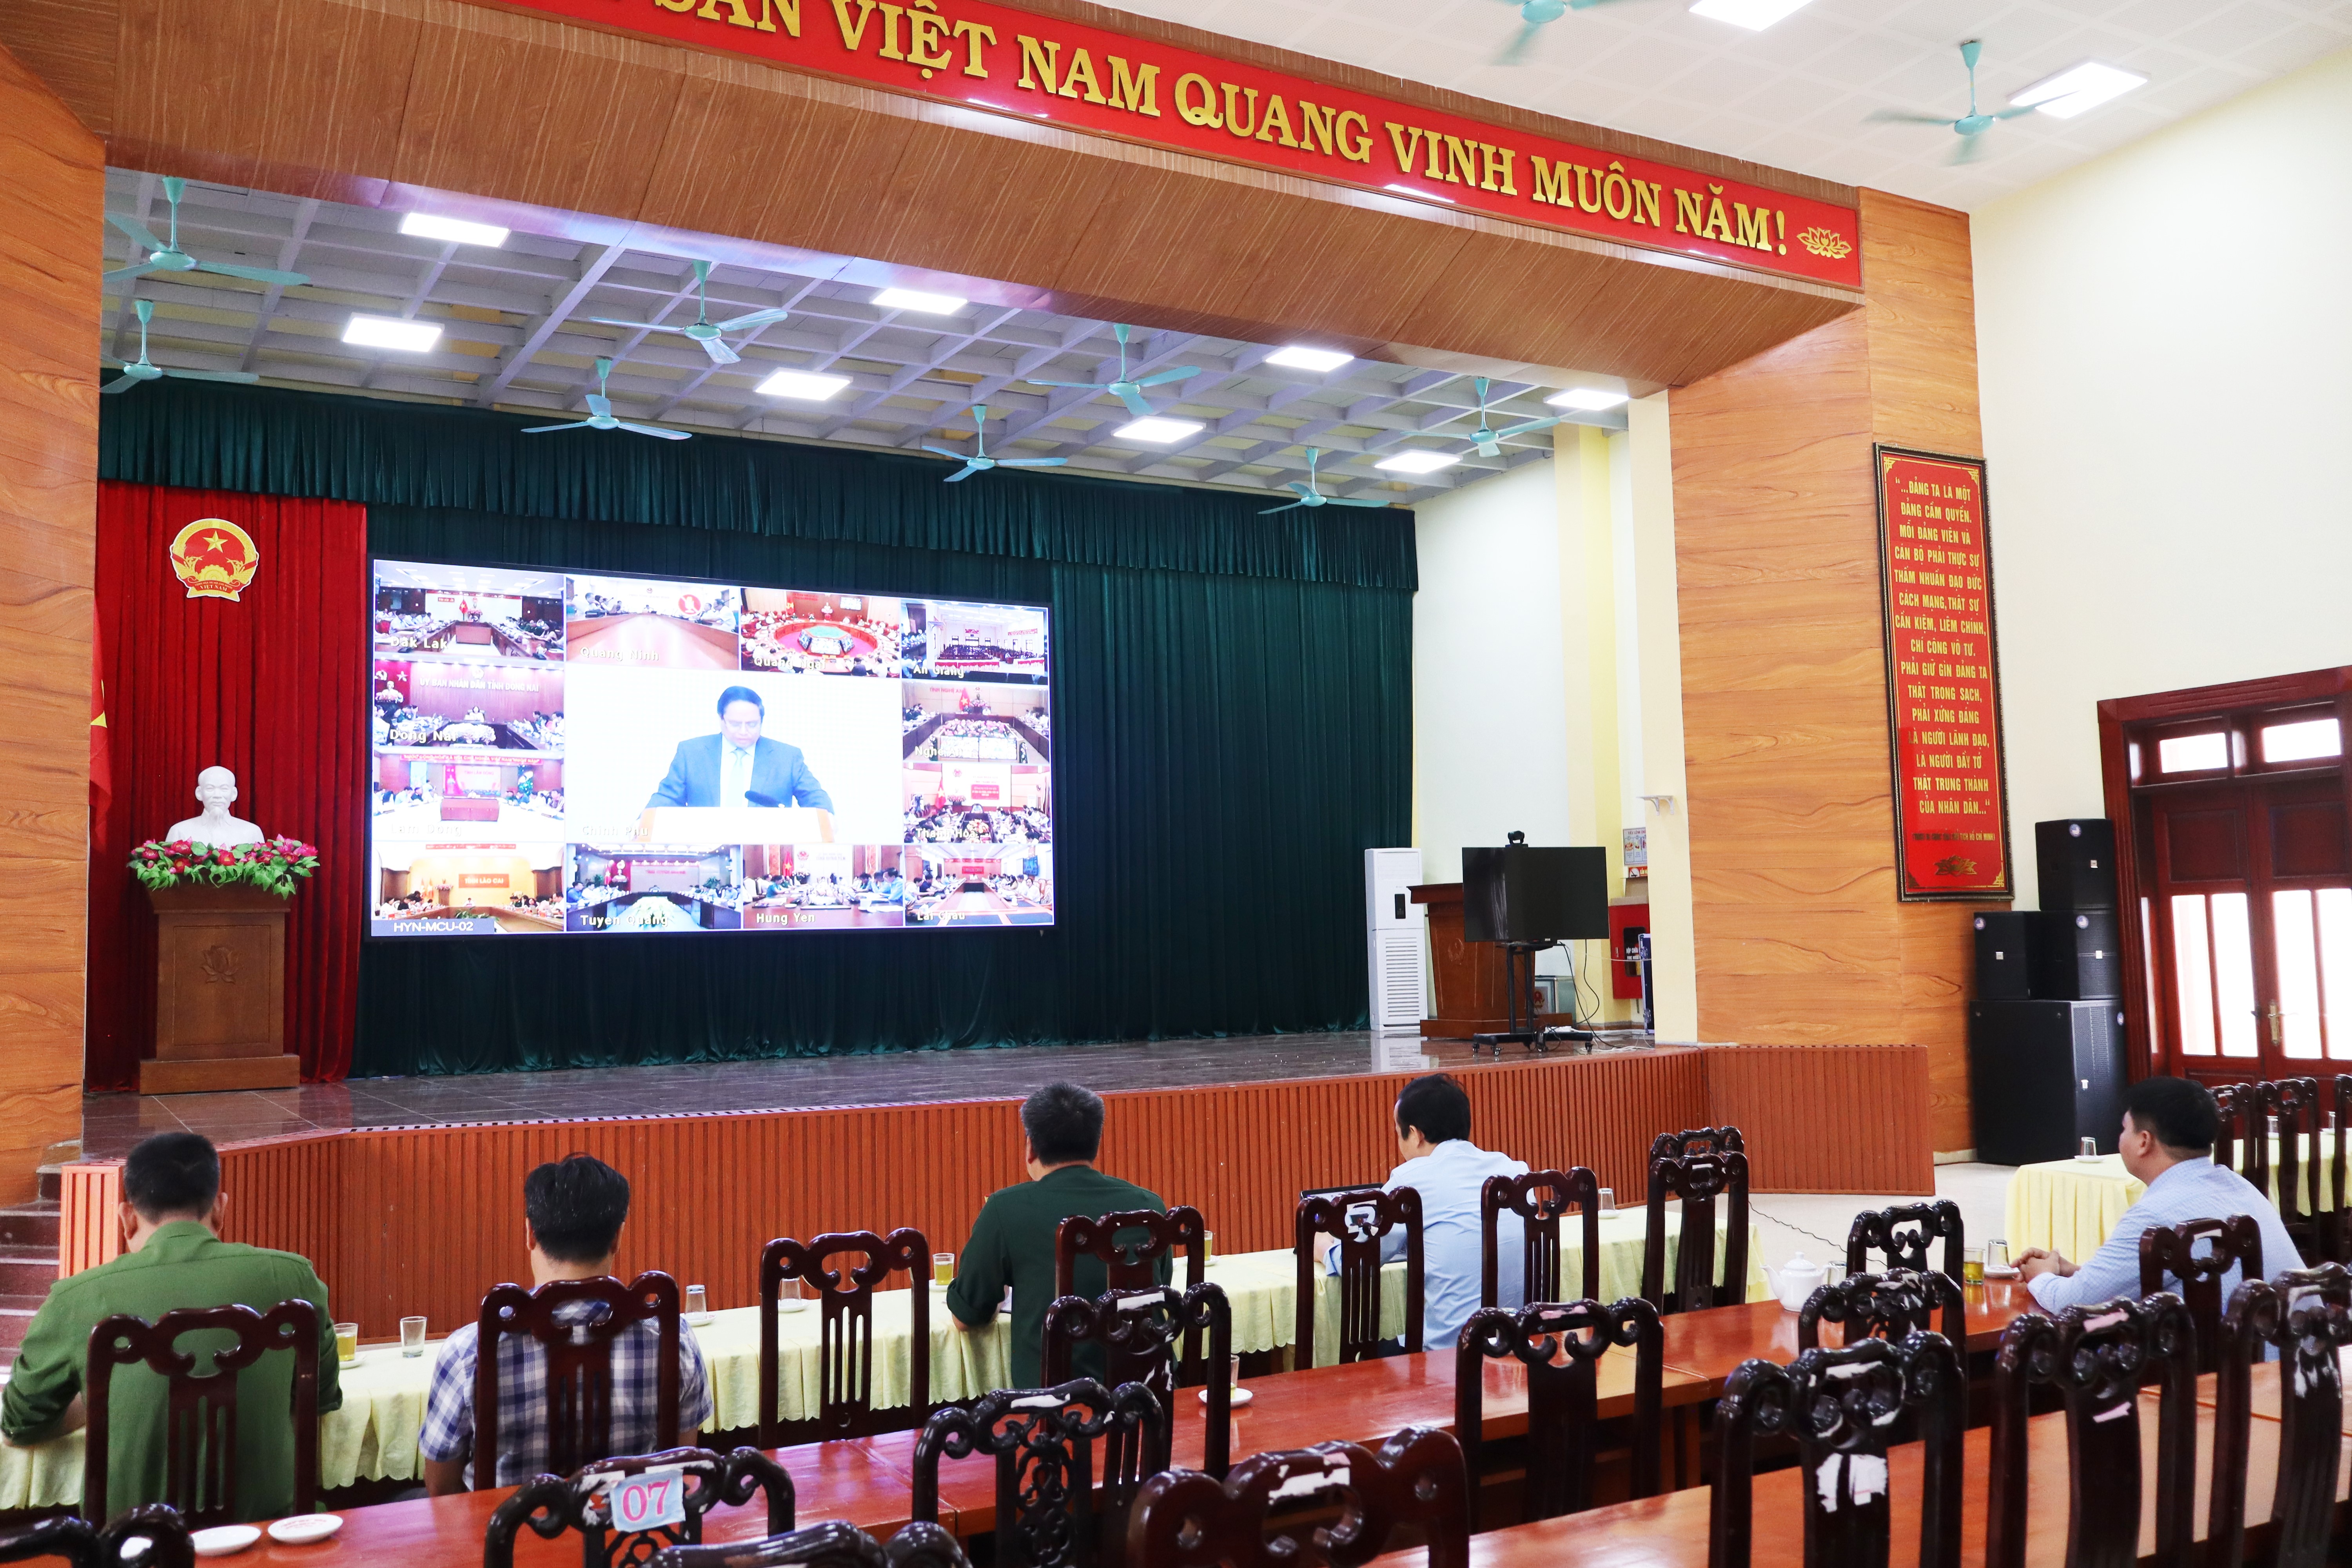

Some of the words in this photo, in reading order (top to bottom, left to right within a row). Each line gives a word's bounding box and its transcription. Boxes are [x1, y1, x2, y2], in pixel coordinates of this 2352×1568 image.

[831, 0, 998, 80] VIỆT
[1017, 34, 1161, 117] NAM
[1174, 72, 1373, 164] QUANG
[1384, 121, 1518, 196] VINH
[1531, 160, 1662, 227] MUÔN
[1673, 183, 1788, 256] NĂM!
[1931, 484, 1940, 497] TA
[1944, 483, 1953, 498] LÀ
[1956, 485, 1970, 504] MỘT
[1901, 497, 1922, 517] ĐẢNG
[1925, 501, 1941, 519] CẦM
[1945, 505, 1971, 523] QUYỀN.
[1900, 520, 1914, 538] MỖI
[1918, 522, 1938, 541] ĐẢNG
[1941, 527, 1958, 543] VIÊN
[1962, 529, 1971, 544] VÀ
[1895, 543, 1910, 560] CÁN
[1914, 545, 1924, 565] BỘ
[1927, 546, 1945, 563] PHẢI
[1948, 552, 1966, 569] THỰC
[1969, 554, 1979, 570] SỰ
[1894, 566, 1915, 583] THẤM
[1919, 569, 1945, 586] NHUẦN
[1949, 575, 1963, 591] ĐẠO
[1967, 574, 1982, 590] ĐỨC
[1899, 590, 1919, 606] CÁCH
[1922, 595, 1947, 611] MẠNG,
[1948, 595, 1965, 613] THẬT
[1969, 599, 1979, 615] SỰ
[1895, 611, 1911, 628] CẦN
[1915, 614, 1936, 633] KIỆM,
[1940, 616, 1957, 632] LIÊM
[1961, 618, 1986, 636] CHÍNH,
[424, 638, 448, 649] Lak
[1911, 637, 1923, 652] CHÍ
[1927, 638, 1947, 654] CÔNG
[1951, 639, 1960, 655] VÔ
[1964, 643, 1975, 656] TƯ.
[580, 647, 623, 662] Quang
[630, 650, 659, 661] Ninh
[754, 657, 793, 670] Quang
[913, 664, 928, 675] An
[1901, 657, 1918, 675] PHẢI
[1922, 659, 1935, 676] GIỮ
[1939, 661, 1952, 677] GÌN
[1956, 660, 1976, 678] ĐẢNG
[1979, 666, 1987, 679] TA
[449, 679, 469, 688] NHÂN
[1908, 682, 1926, 702] THẬT
[1931, 686, 1955, 700] TRONG
[1960, 688, 1982, 704] SẠCH,
[1912, 703, 1930, 721] PHẢI
[1934, 706, 1955, 722] XỨNG
[390, 729, 427, 744] Dong
[433, 730, 457, 742] Nai
[1908, 728, 1918, 744] LÀ
[1922, 728, 1945, 744] NGƯỜI
[1949, 730, 1969, 746] LÃNH
[1973, 734, 1989, 749] ĐẠO,
[915, 746, 943, 758] Nghe
[1916, 751, 1926, 767] LÀ
[1929, 751, 1953, 768] NGƯỜI
[1957, 751, 1970, 768] ĐẦY
[1973, 752, 1982, 768] TỚ
[1913, 774, 1931, 794] THẬT
[1935, 778, 1960, 791] TRUNG
[1964, 775, 1988, 791] THÀNH
[1920, 794, 1935, 813] CỦA
[1938, 798, 1959, 813] NHÂN
[427, 824, 462, 837] Dong
[582, 825, 618, 836] Chinh
[625, 826, 648, 836] Phu
[580, 915, 621, 928] Tuyen
[626, 915, 668, 927] Quang
[756, 913, 788, 926] Hung
[793, 913, 816, 922] Yen
[917, 911, 934, 920] Lai
[393, 921, 474, 933] HYN-MCU-02
[622, 1479, 671, 1522] 07
